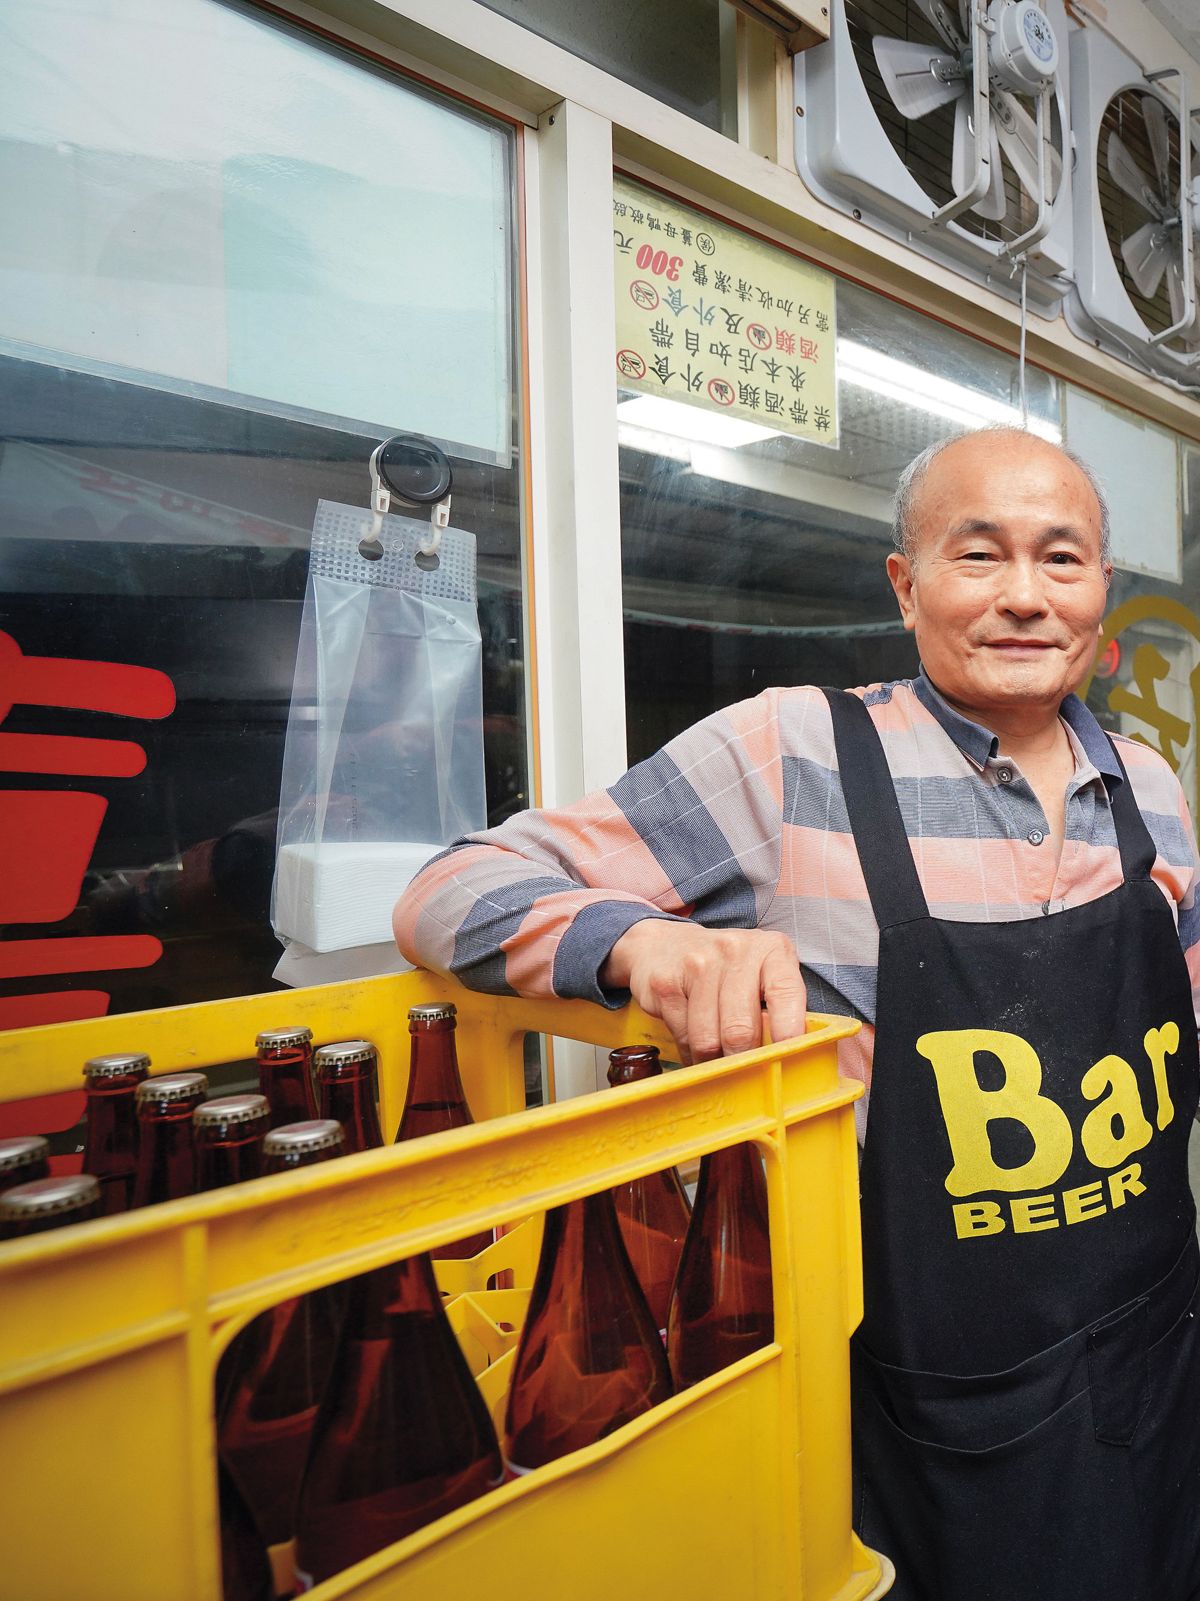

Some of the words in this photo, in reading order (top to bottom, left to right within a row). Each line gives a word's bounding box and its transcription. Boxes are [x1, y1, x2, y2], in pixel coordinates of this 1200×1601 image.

[648, 318, 806, 392] 來本店如自帶
[649, 354, 704, 392] 外食
[774, 326, 820, 363] 酒類
[738, 380, 830, 432] 禁帶酒類
[916, 1021, 1180, 1197] Bar
[952, 1163, 1147, 1239] BEER
